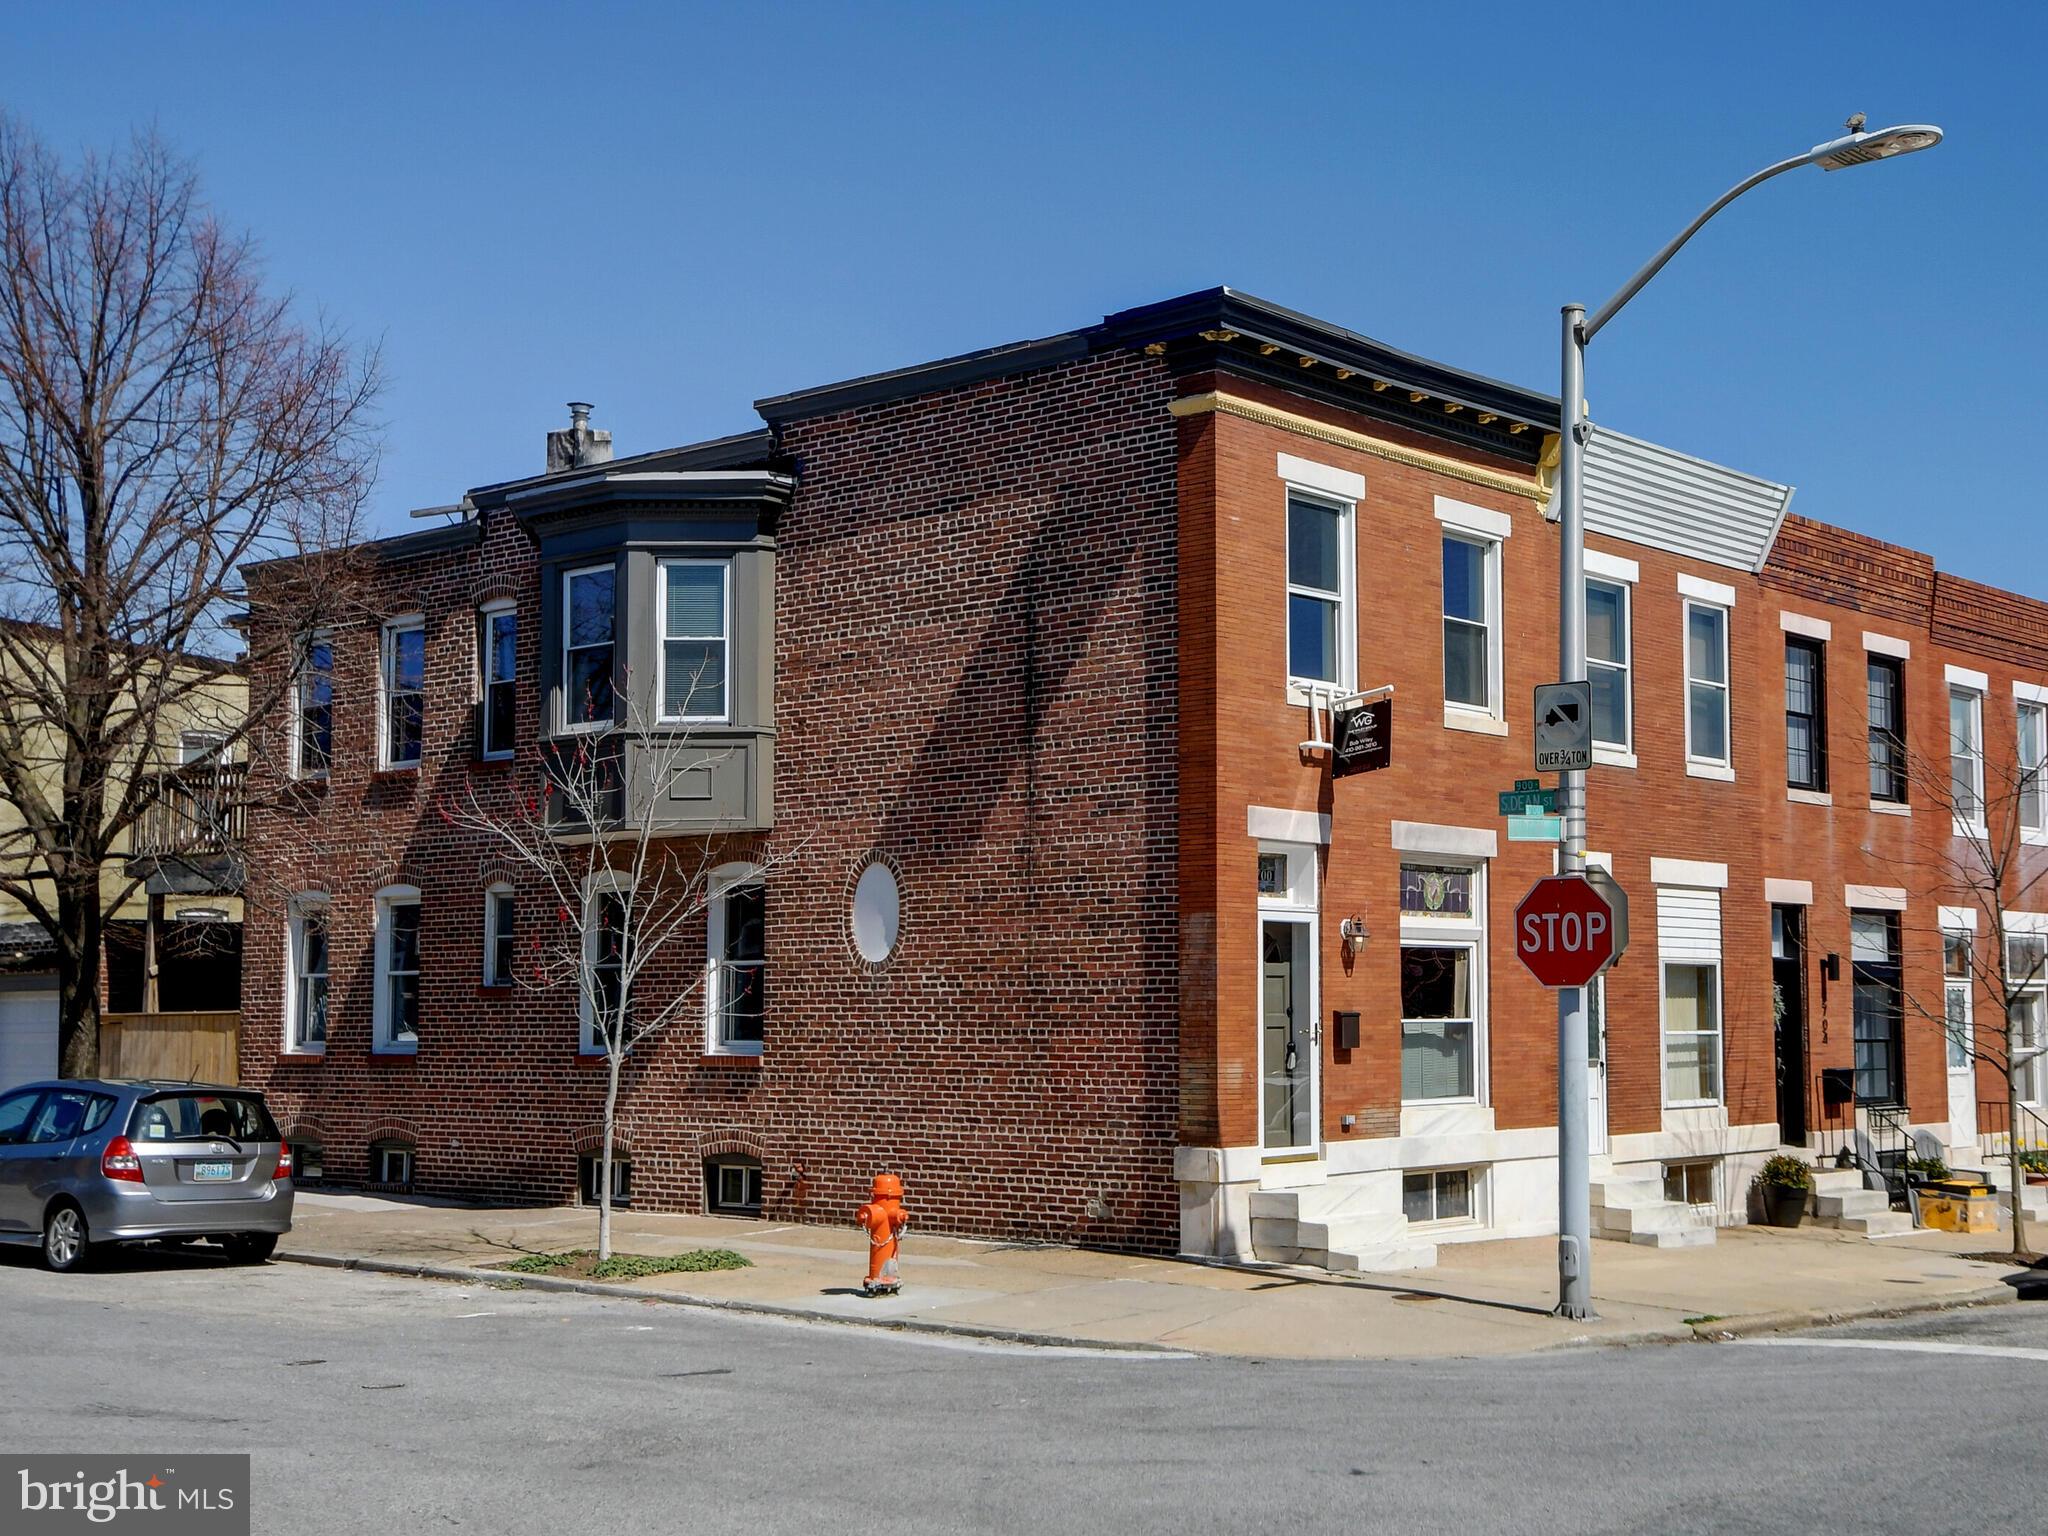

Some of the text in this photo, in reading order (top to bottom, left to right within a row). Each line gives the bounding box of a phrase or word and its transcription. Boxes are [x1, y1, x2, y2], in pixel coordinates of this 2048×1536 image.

[1352, 715, 1372, 728] WG
[1539, 752, 1559, 765] OVER
[1571, 750, 1587, 763] TON
[1515, 780, 1533, 790] 900
[1543, 796, 1553, 807] ST
[1522, 911, 1606, 953] STOP
